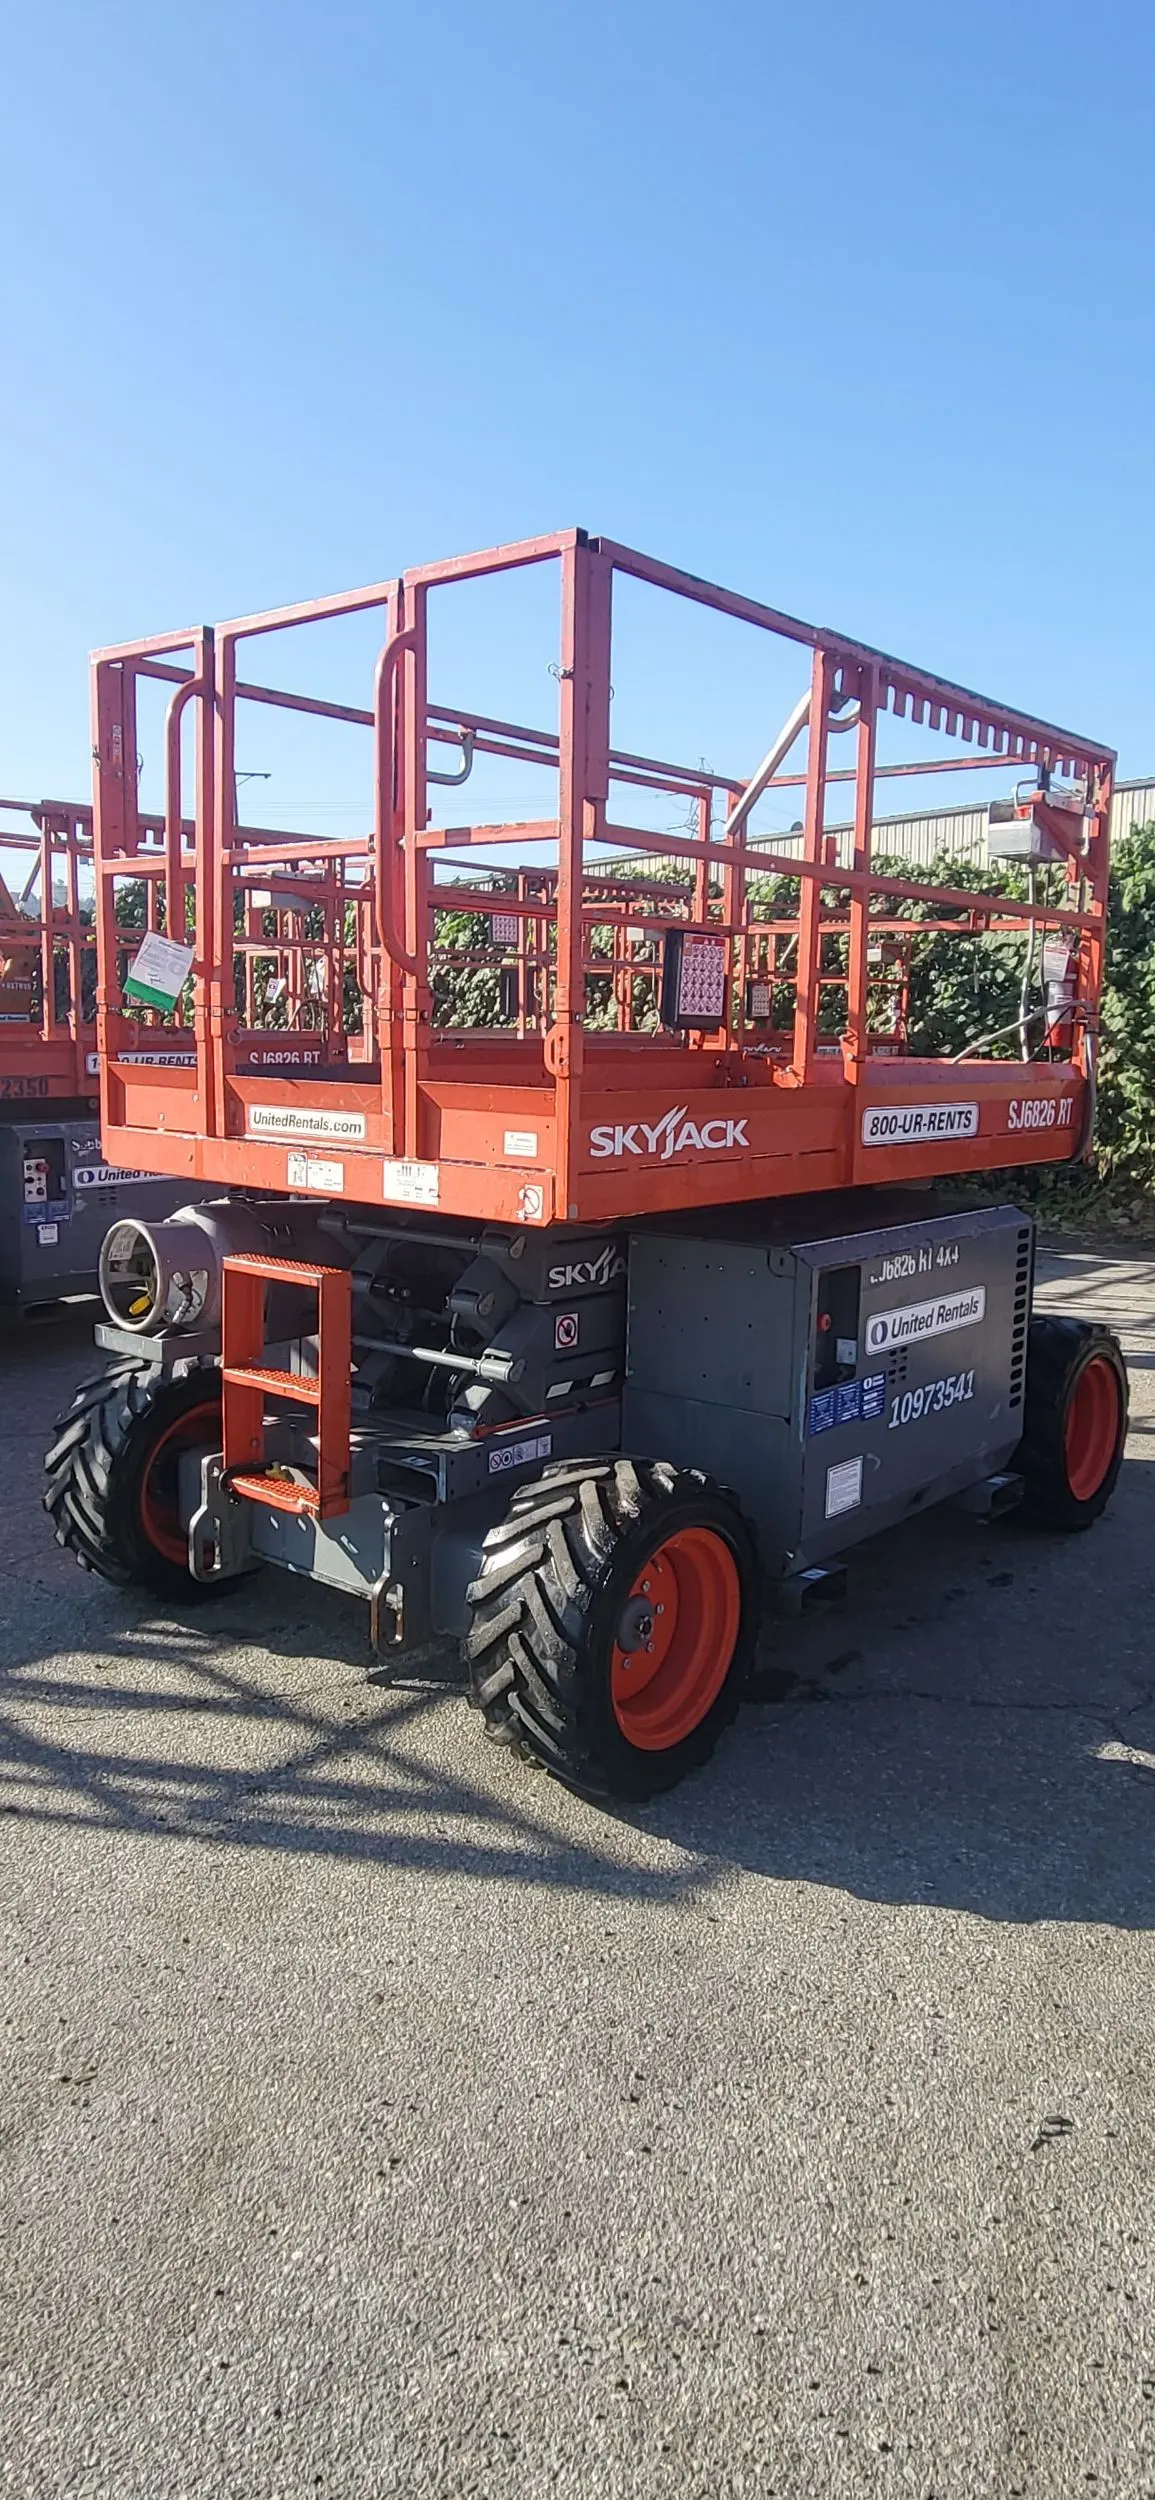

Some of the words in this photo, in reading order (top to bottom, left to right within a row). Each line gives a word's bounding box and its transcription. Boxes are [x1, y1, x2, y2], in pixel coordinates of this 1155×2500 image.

[253, 1111, 362, 1134] UnitedRentals.com
[870, 1110, 973, 1136] 800-UR-RENTS
[1007, 1100, 1056, 1129] SJ6826
[1057, 1098, 1074, 1125] RT
[590, 1104, 750, 1160] SKYJACK
[97, 1169, 140, 1182] United
[891, 1307, 935, 1339] United
[936, 1295, 980, 1326] Rentals
[888, 1369, 975, 1429] 10973541
